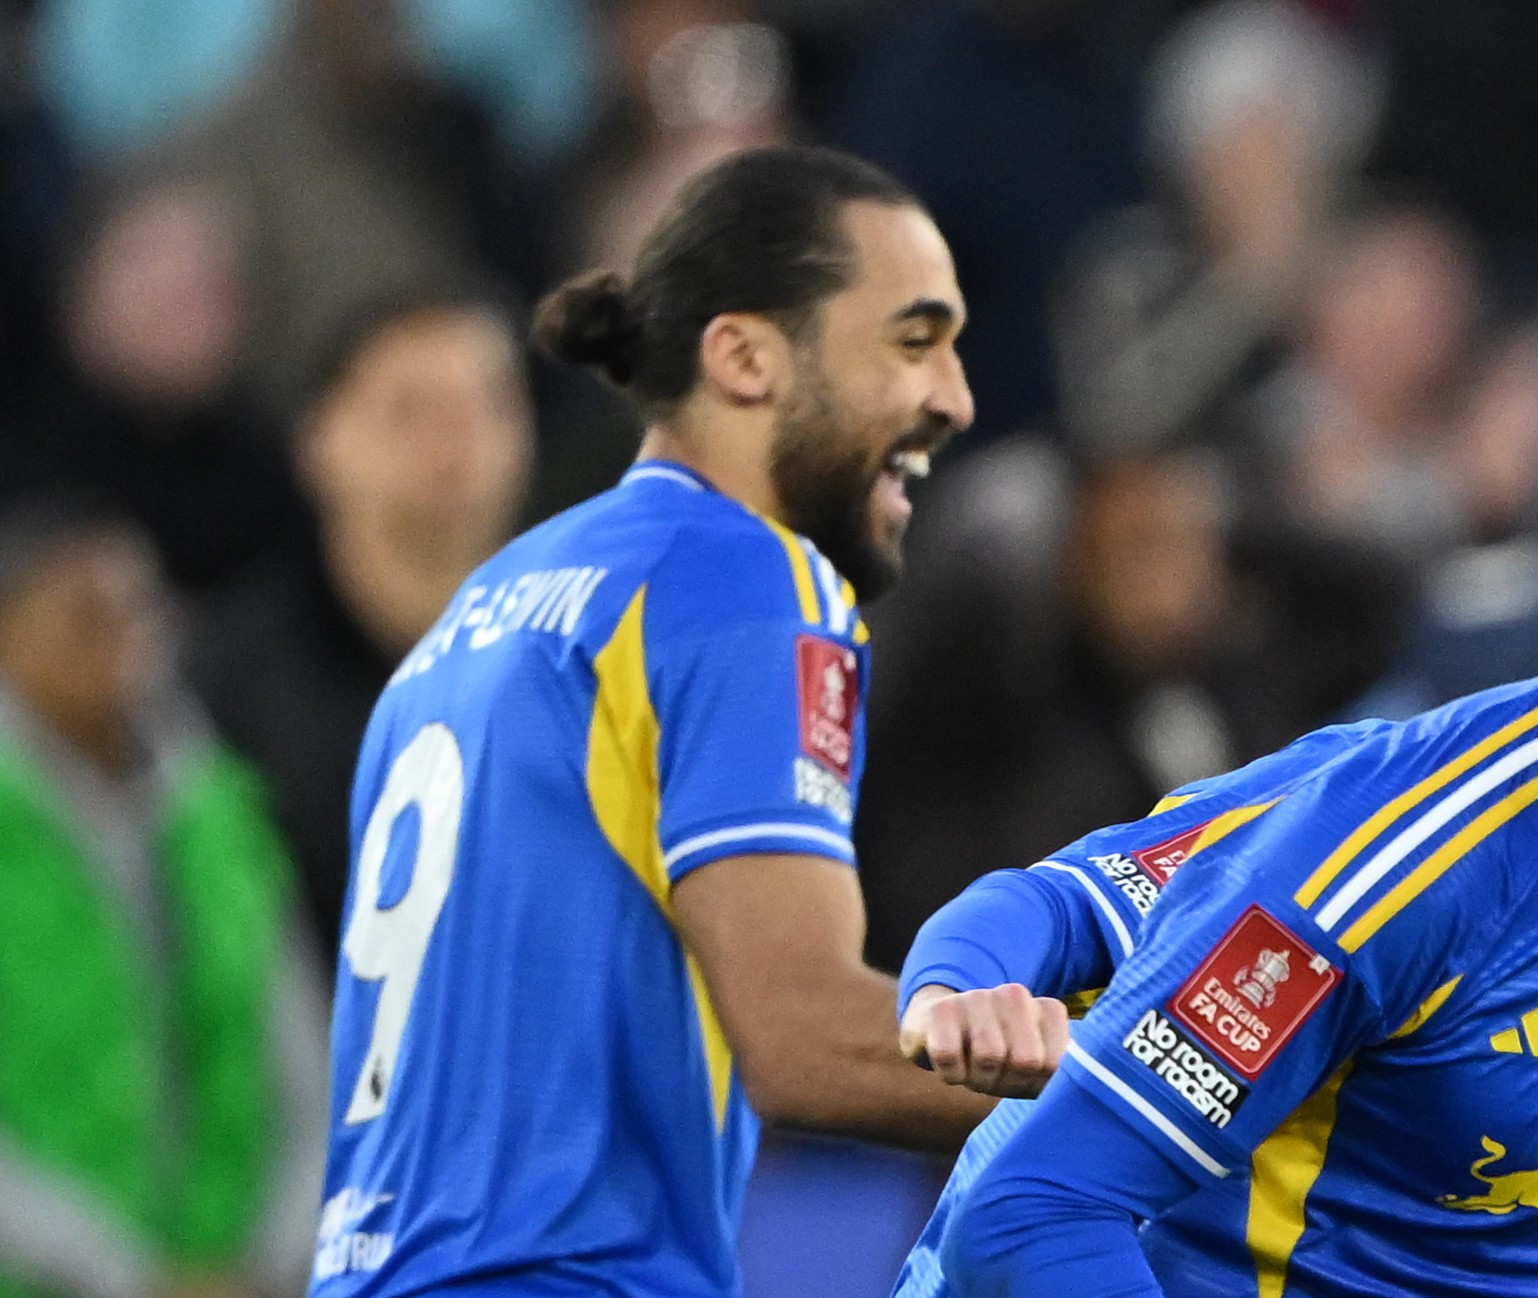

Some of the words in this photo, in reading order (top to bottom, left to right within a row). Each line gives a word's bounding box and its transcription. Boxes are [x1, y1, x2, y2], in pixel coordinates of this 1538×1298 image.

[1100, 853, 1138, 875] No
[1130, 874, 1161, 906] ro
[1113, 878, 1152, 918] rac
[343, 723, 463, 1125] 9
[1189, 993, 1218, 1024] FA
[1217, 1014, 1262, 1053] CUP
[1203, 976, 1272, 1040] Emirates
[1122, 1027, 1165, 1066] for
[1156, 1057, 1232, 1129] racism
[1137, 1009, 1177, 1050] No
[1171, 1041, 1239, 1105] room
